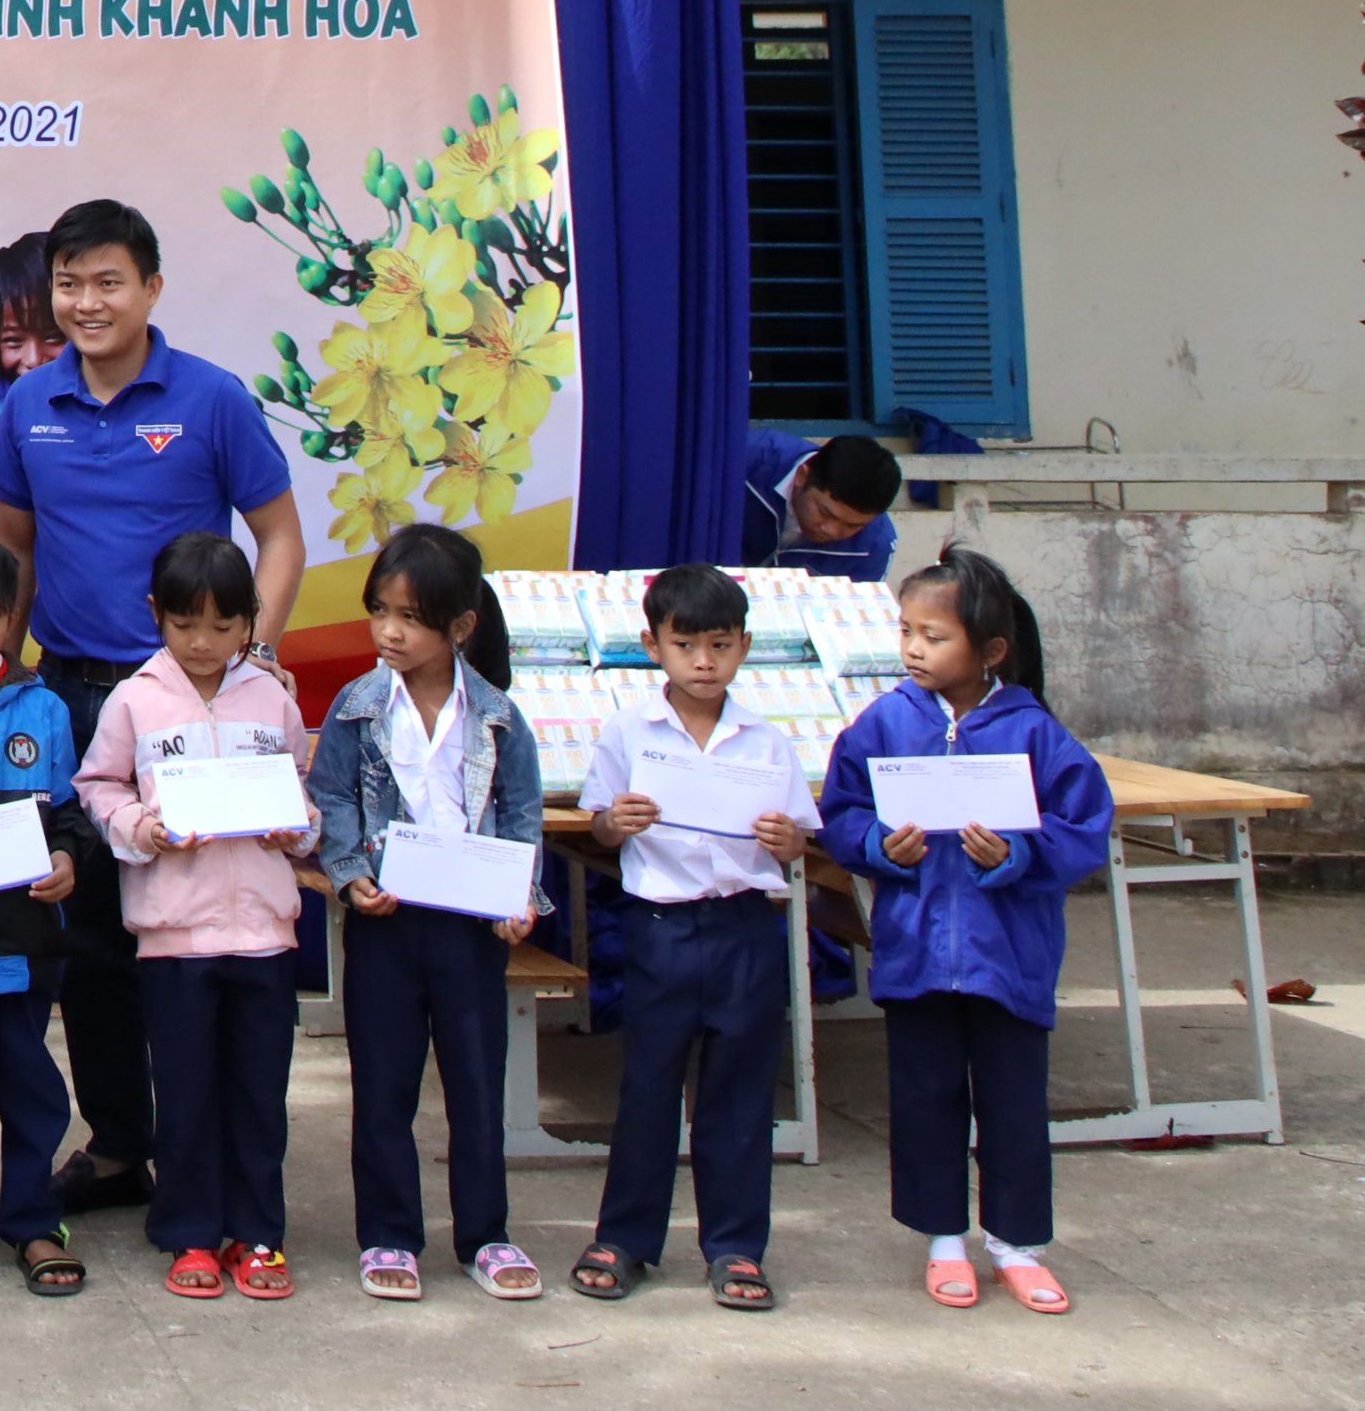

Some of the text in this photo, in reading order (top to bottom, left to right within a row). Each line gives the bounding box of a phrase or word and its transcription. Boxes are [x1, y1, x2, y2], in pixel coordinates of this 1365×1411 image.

[30, 425, 48, 434] ACV
[641, 749, 668, 761] ACV
[162, 768, 184, 777] ACV
[877, 764, 902, 772] ACV
[395, 828, 419, 840] ACV
